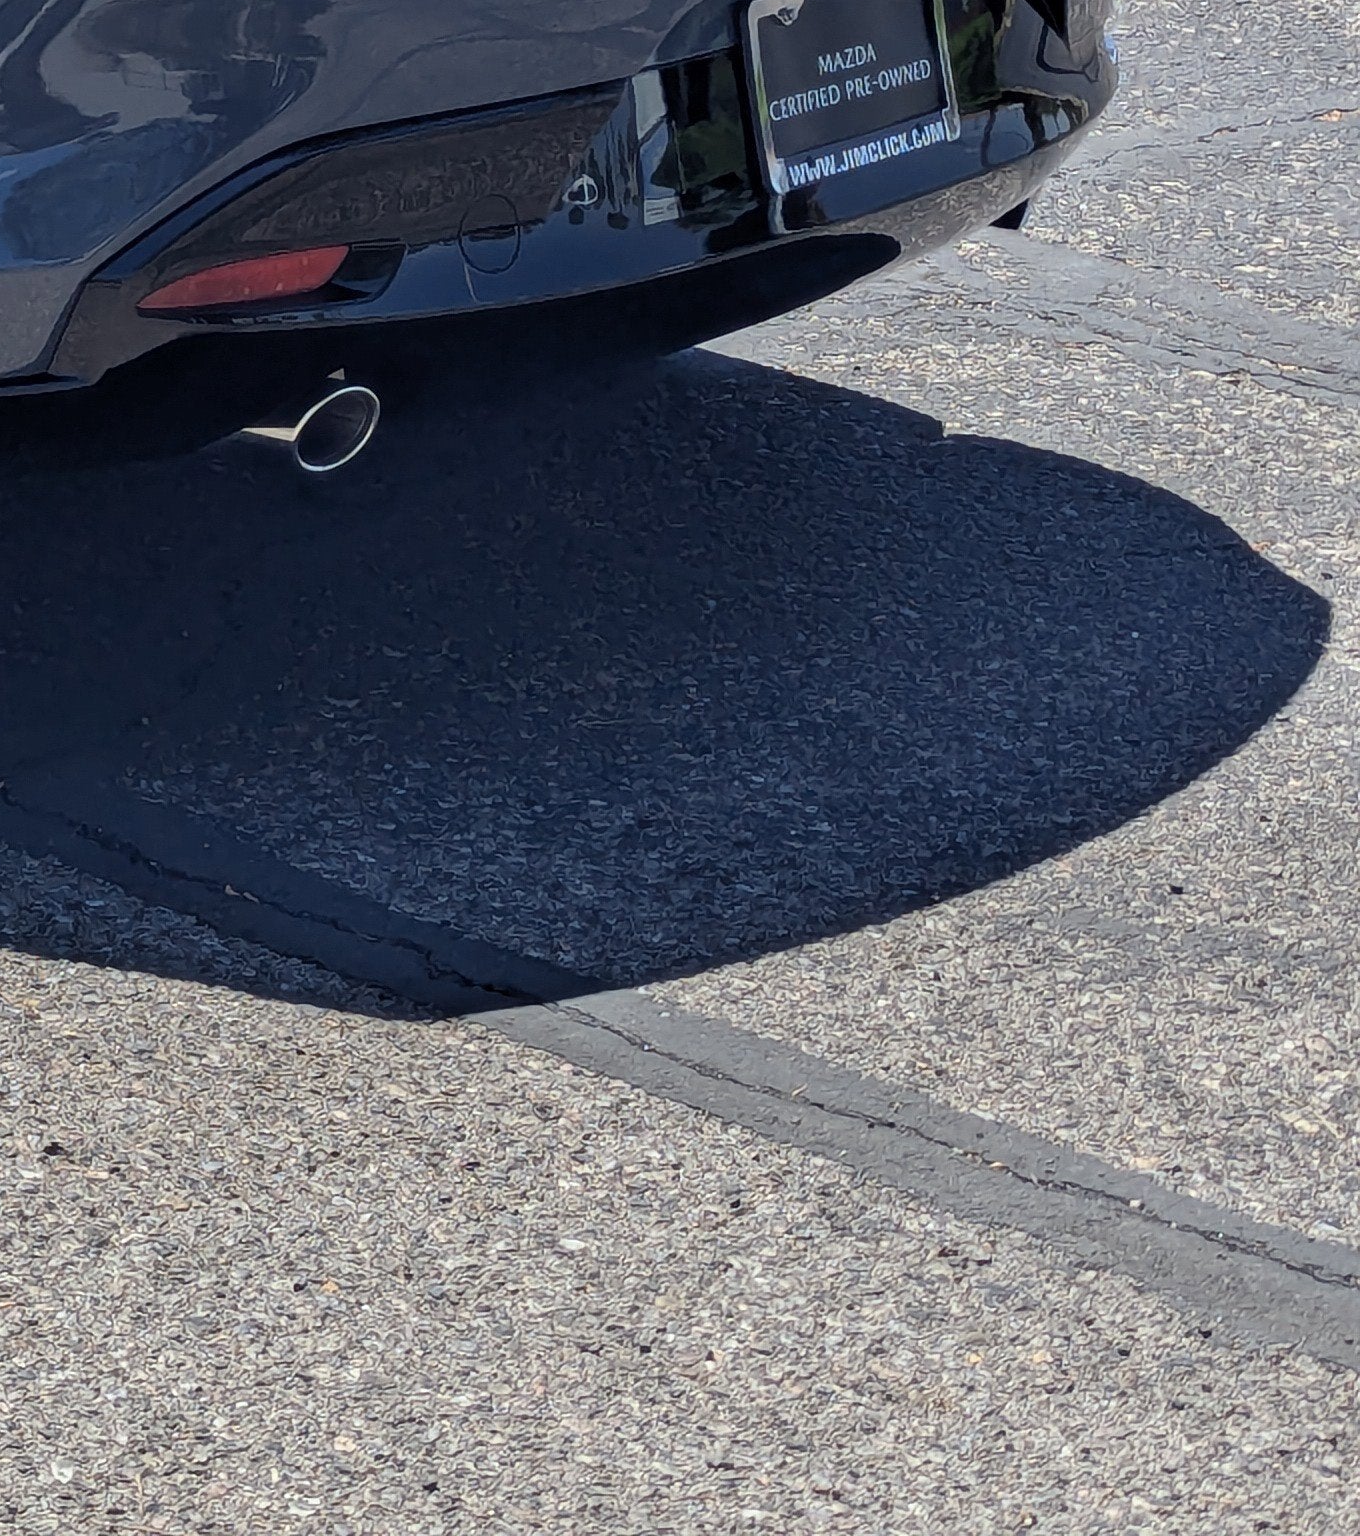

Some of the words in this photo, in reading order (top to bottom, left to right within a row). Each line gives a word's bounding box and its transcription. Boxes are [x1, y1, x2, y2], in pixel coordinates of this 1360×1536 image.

[769, 84, 841, 122] CERTIFIED
[845, 59, 931, 101] PRE-OWNED
[817, 43, 877, 76] MAZDA
[788, 121, 945, 187] WWW.JIMCLICK.COM
